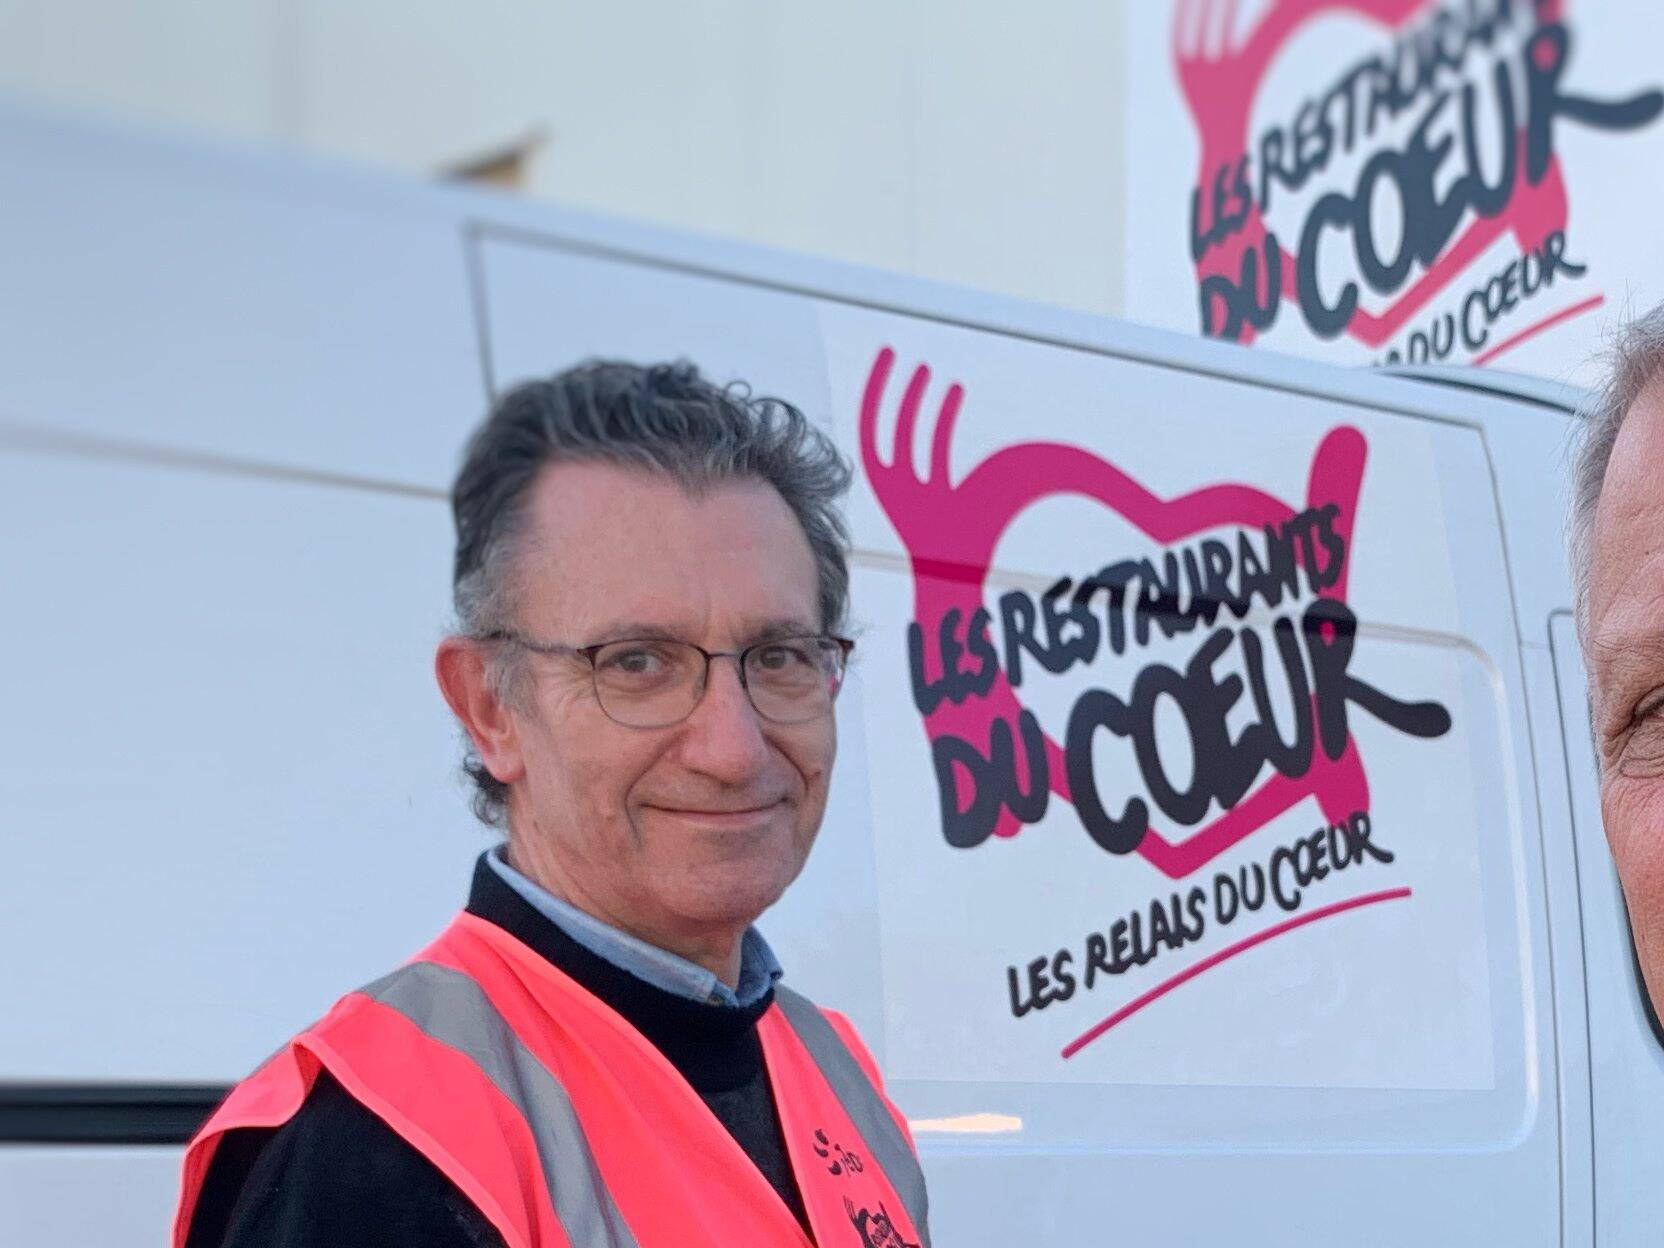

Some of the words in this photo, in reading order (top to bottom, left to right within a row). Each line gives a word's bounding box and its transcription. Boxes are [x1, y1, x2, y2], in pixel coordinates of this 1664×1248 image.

[1191, 154, 1254, 263] LES
[1200, 232, 1281, 342] DU
[907, 605, 999, 714] LES
[999, 502, 1346, 688] RESTAURANTS
[931, 709, 1050, 849] DU
[1007, 948, 1076, 1017] LES
[1084, 885, 1206, 989] RELAIS
[1213, 861, 1265, 925] DU
